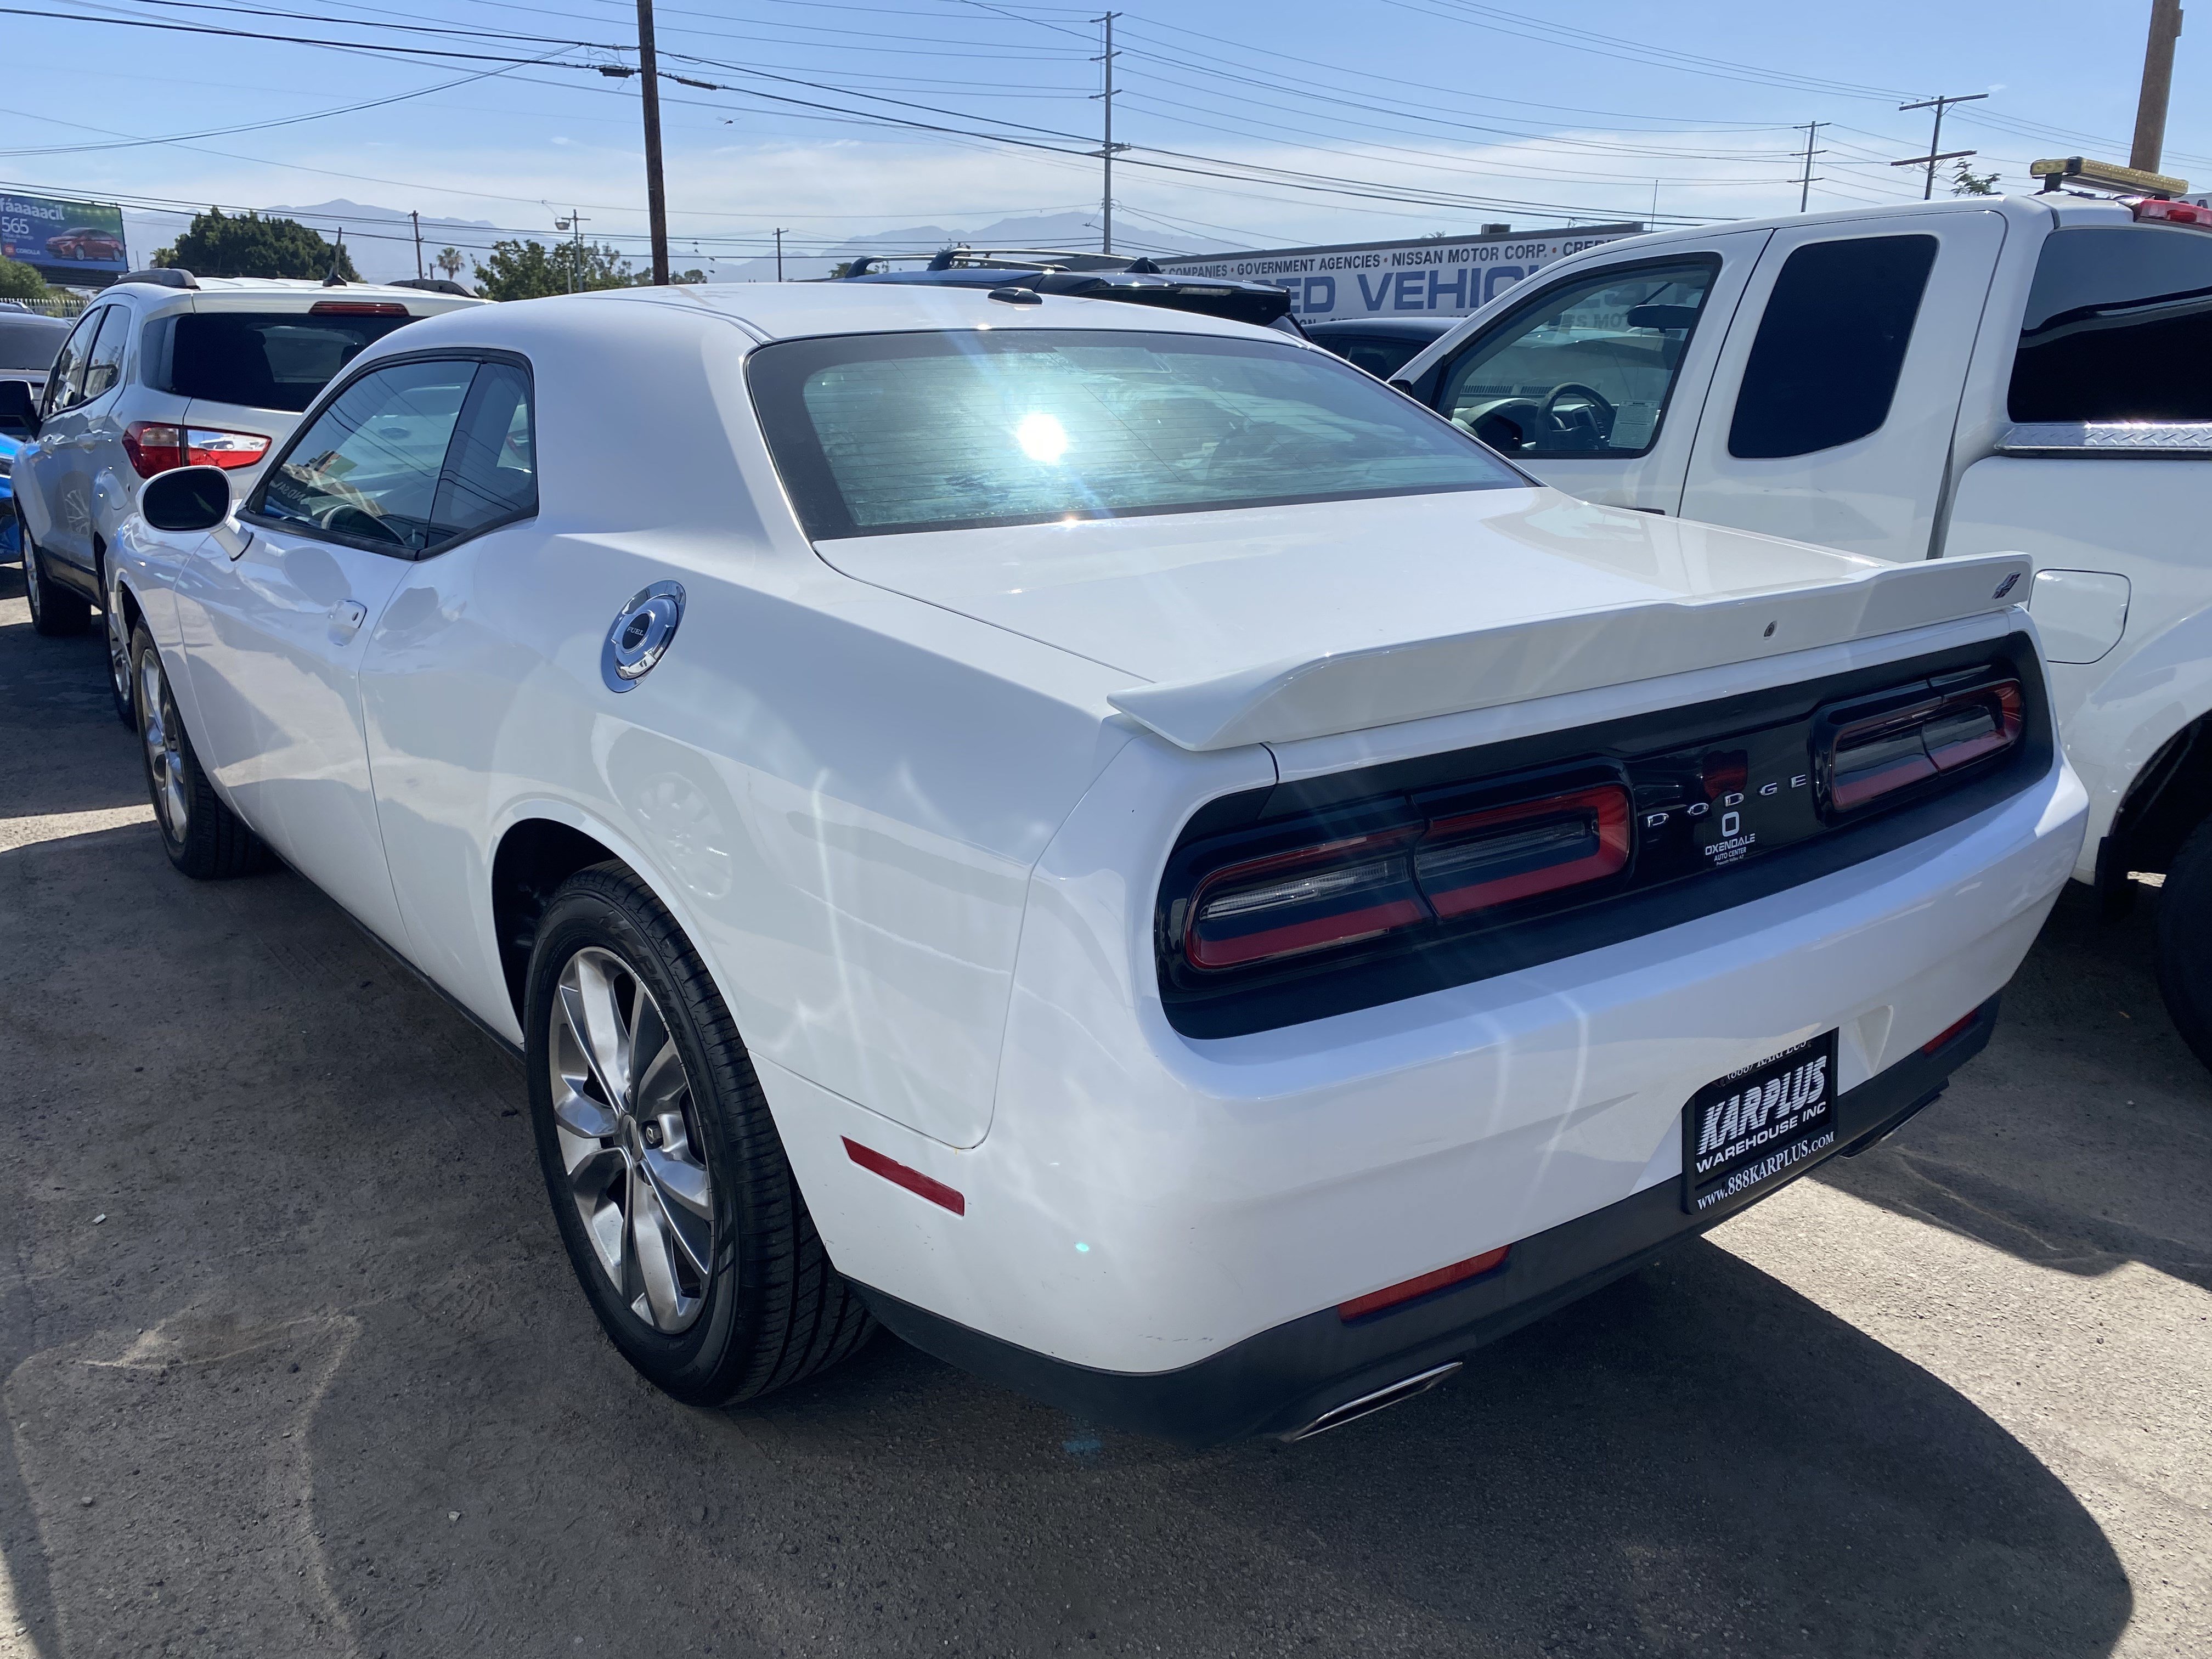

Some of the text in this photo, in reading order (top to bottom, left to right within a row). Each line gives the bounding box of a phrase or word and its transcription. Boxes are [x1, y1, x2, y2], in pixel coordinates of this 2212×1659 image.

[2, 216, 30, 234] 565
[1238, 258, 1316, 275] GOVERNMENT
[1319, 254, 1380, 270] AGENCIES
[1391, 250, 1444, 267] NISSAN
[1448, 246, 1499, 263] MOTOR
[1505, 244, 1547, 260] CORP.
[1357, 264, 1540, 312] VEHIC
[627, 627, 644, 636] FUEL
[1647, 774, 1807, 827] DODGE
[1705, 833, 1756, 855] OXENDALE
[1714, 847, 1746, 862] AUTO CENTER
[1696, 1056, 1827, 1155] KARPLUS
[1696, 1102, 1826, 1173] WAREHOUSE INC
